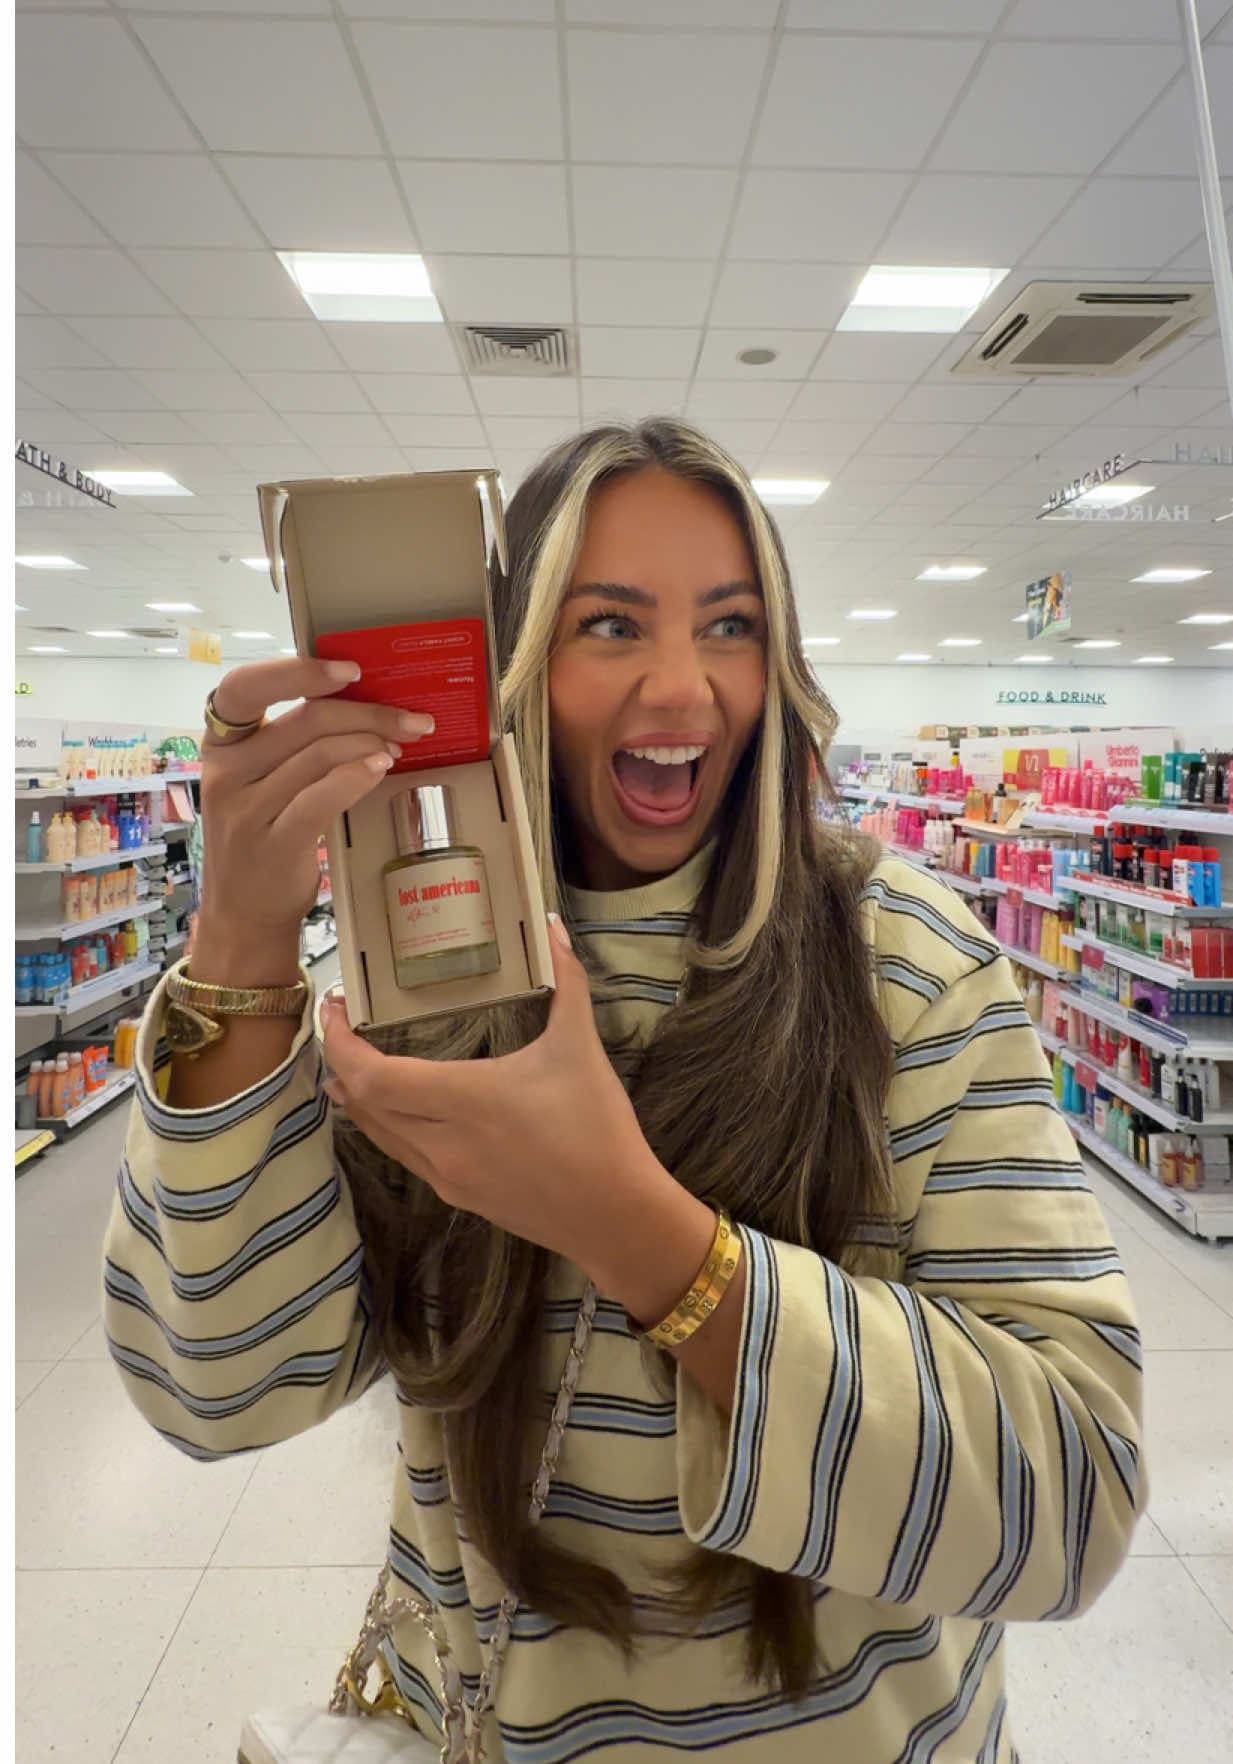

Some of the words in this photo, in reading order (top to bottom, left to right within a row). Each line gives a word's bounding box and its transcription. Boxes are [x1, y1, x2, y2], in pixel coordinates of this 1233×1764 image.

[58, 461, 68, 482] &
[76, 469, 112, 504] BODY
[1048, 454, 1124, 505] HAIRCARE
[997, 690, 1040, 702] FOOD
[1046, 690, 1057, 703] &
[1061, 690, 1107, 704] DRINK
[397, 885, 419, 907] lost
